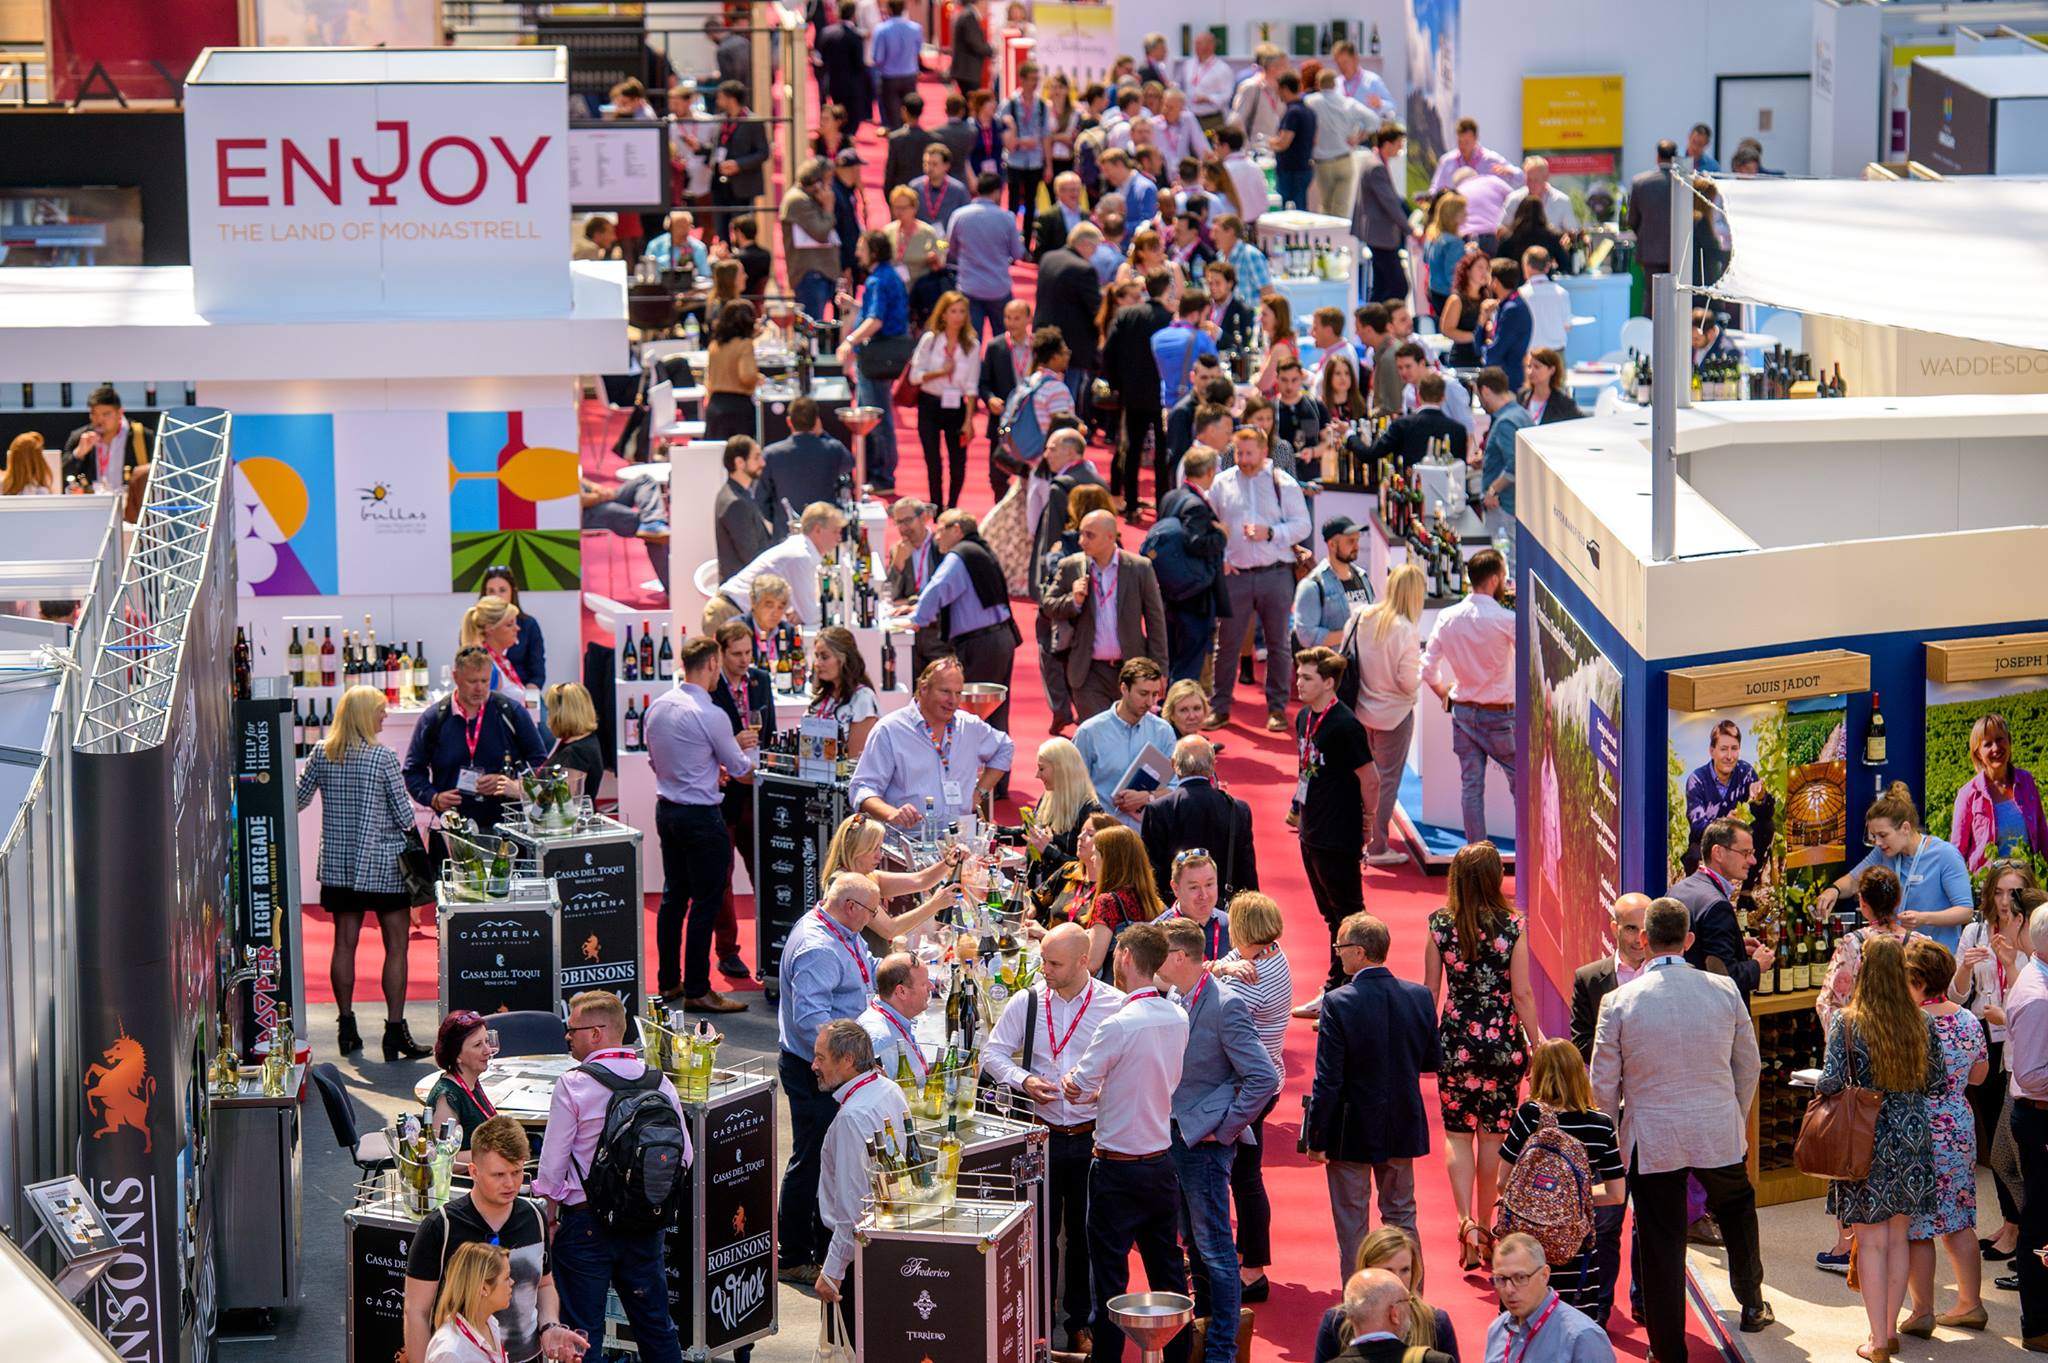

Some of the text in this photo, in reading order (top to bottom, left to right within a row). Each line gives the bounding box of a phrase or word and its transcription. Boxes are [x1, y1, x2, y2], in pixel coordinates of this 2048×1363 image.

[216, 121, 552, 206] ENJOY
[217, 221, 540, 241] THE LAND OF MONASTRELL
[1995, 655, 2042, 672] JOSEPH
[1746, 675, 1820, 695] LOUIS JADOT
[245, 722, 259, 769] HELP for
[258, 721, 270, 769] HEROES
[250, 815, 271, 937] LIGHT BRIGADE
[554, 865, 625, 880] CASAS DEL TOQUI
[564, 899, 625, 912] ASARENA
[460, 930, 540, 939] CASARENA
[460, 968, 540, 980] CASAS DEL TOQUI
[561, 964, 635, 985] OBINSONS
[253, 944, 277, 1047] ROOPER
[712, 1115, 765, 1139] CASARENA
[712, 1159, 765, 1184] CASAS DEL TOQUI
[365, 1253, 408, 1269] CASAS DE
[708, 1235, 771, 1272] ROBINSONS
[366, 1297, 402, 1310] CASA
[711, 1266, 768, 1331] Wines
